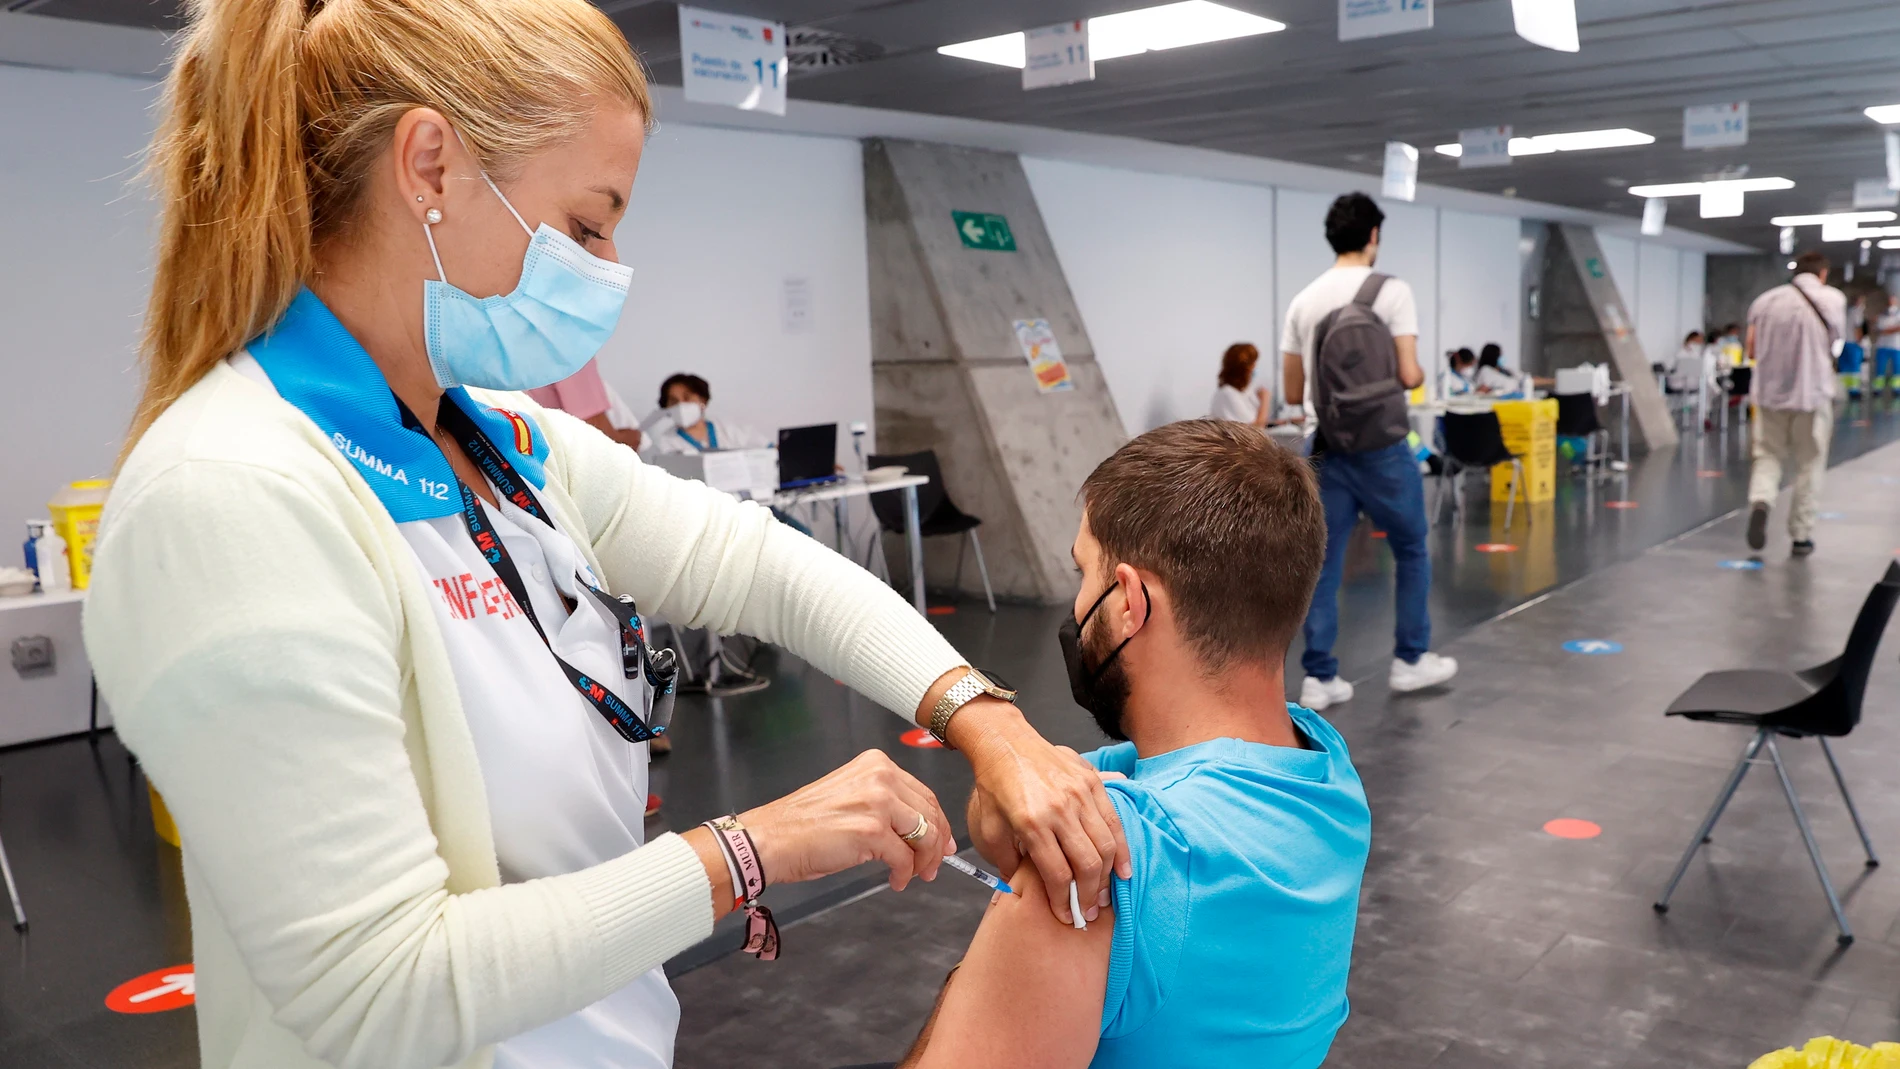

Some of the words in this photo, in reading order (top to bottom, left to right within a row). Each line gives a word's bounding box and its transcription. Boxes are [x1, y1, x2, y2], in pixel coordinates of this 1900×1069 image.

[753, 57, 778, 89] 11
[1066, 44, 1085, 65] 11
[331, 431, 409, 486] SUMMA
[418, 477, 449, 501] 112
[467, 439, 485, 457] 112
[482, 456, 515, 495] SUMMA
[463, 486, 482, 532] SUMMA
[604, 694, 634, 727] SUMMA
[632, 723, 648, 740] 112
[731, 833, 755, 871] MUJER
